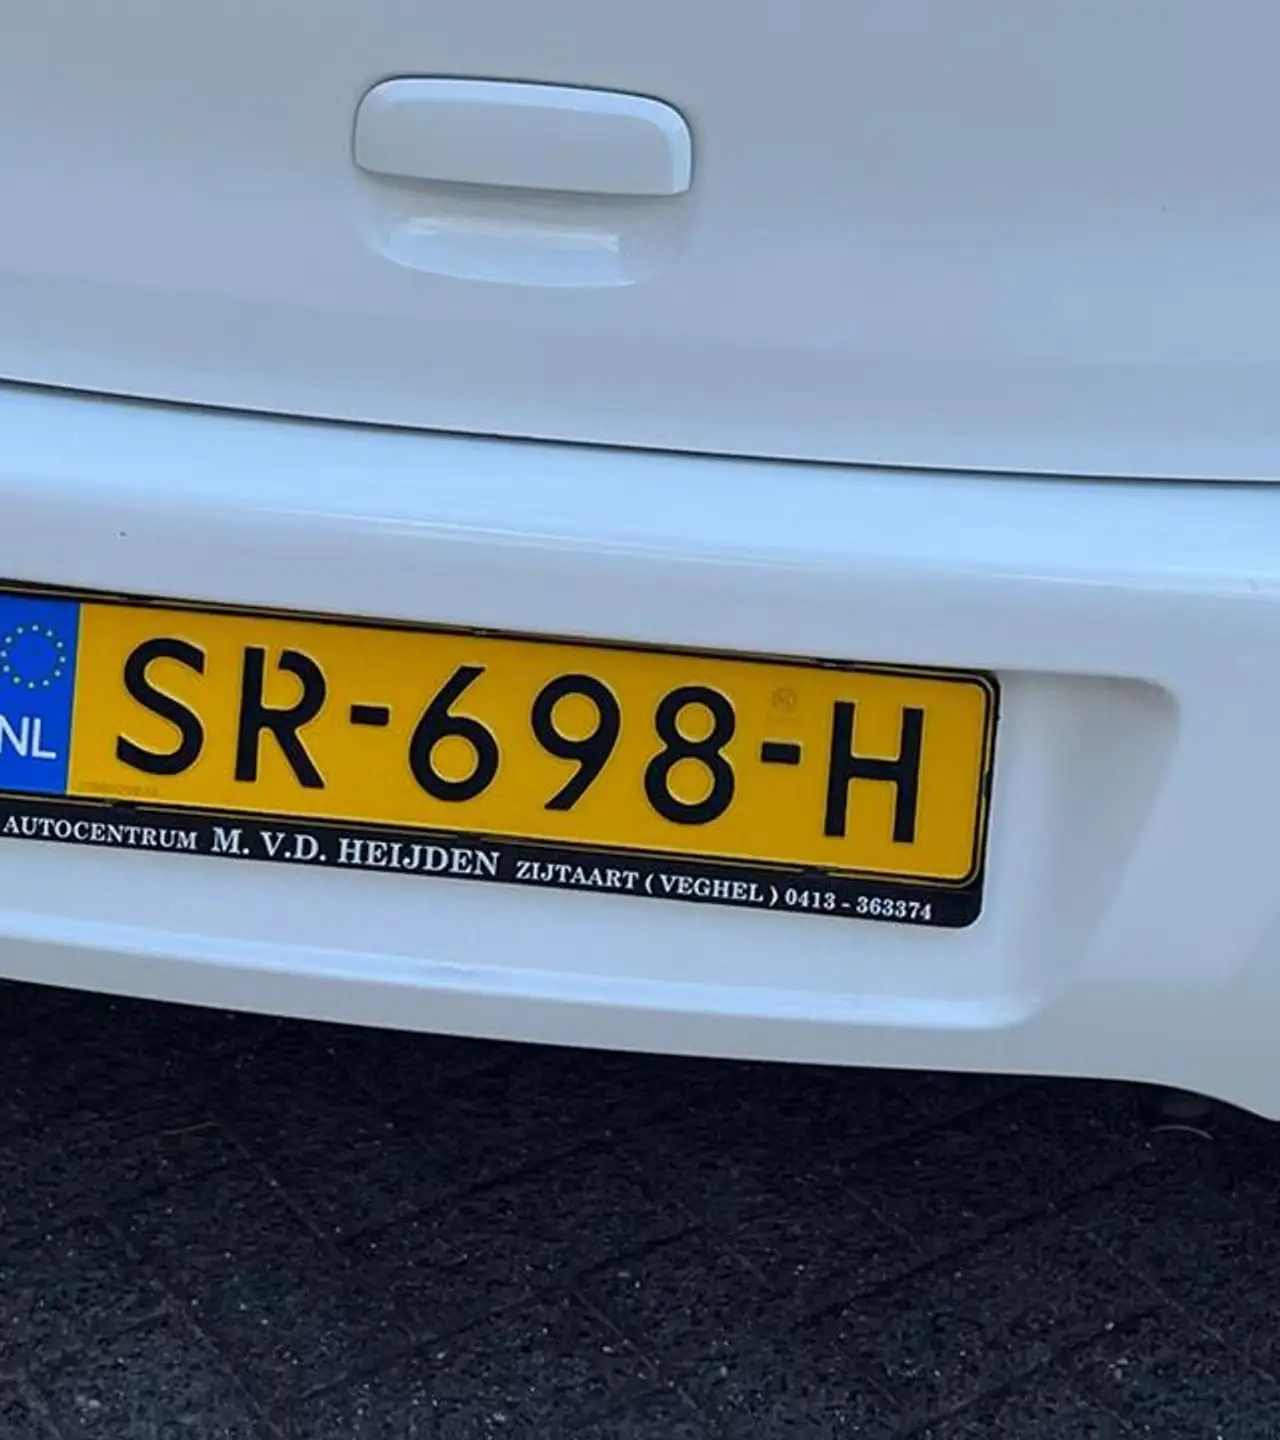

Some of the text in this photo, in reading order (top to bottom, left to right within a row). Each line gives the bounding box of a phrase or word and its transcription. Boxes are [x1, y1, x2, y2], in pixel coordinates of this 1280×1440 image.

[116, 637, 925, 844] SR-698-H
[3, 815, 199, 850] AUTOCENTRUM
[210, 826, 250, 855] M.
[260, 830, 326, 861] V.D.
[337, 837, 501, 877] HEIJDEN
[515, 860, 640, 890] ZIJTAART
[784, 887, 837, 910] 0413
[855, 895, 932, 921] 363374
